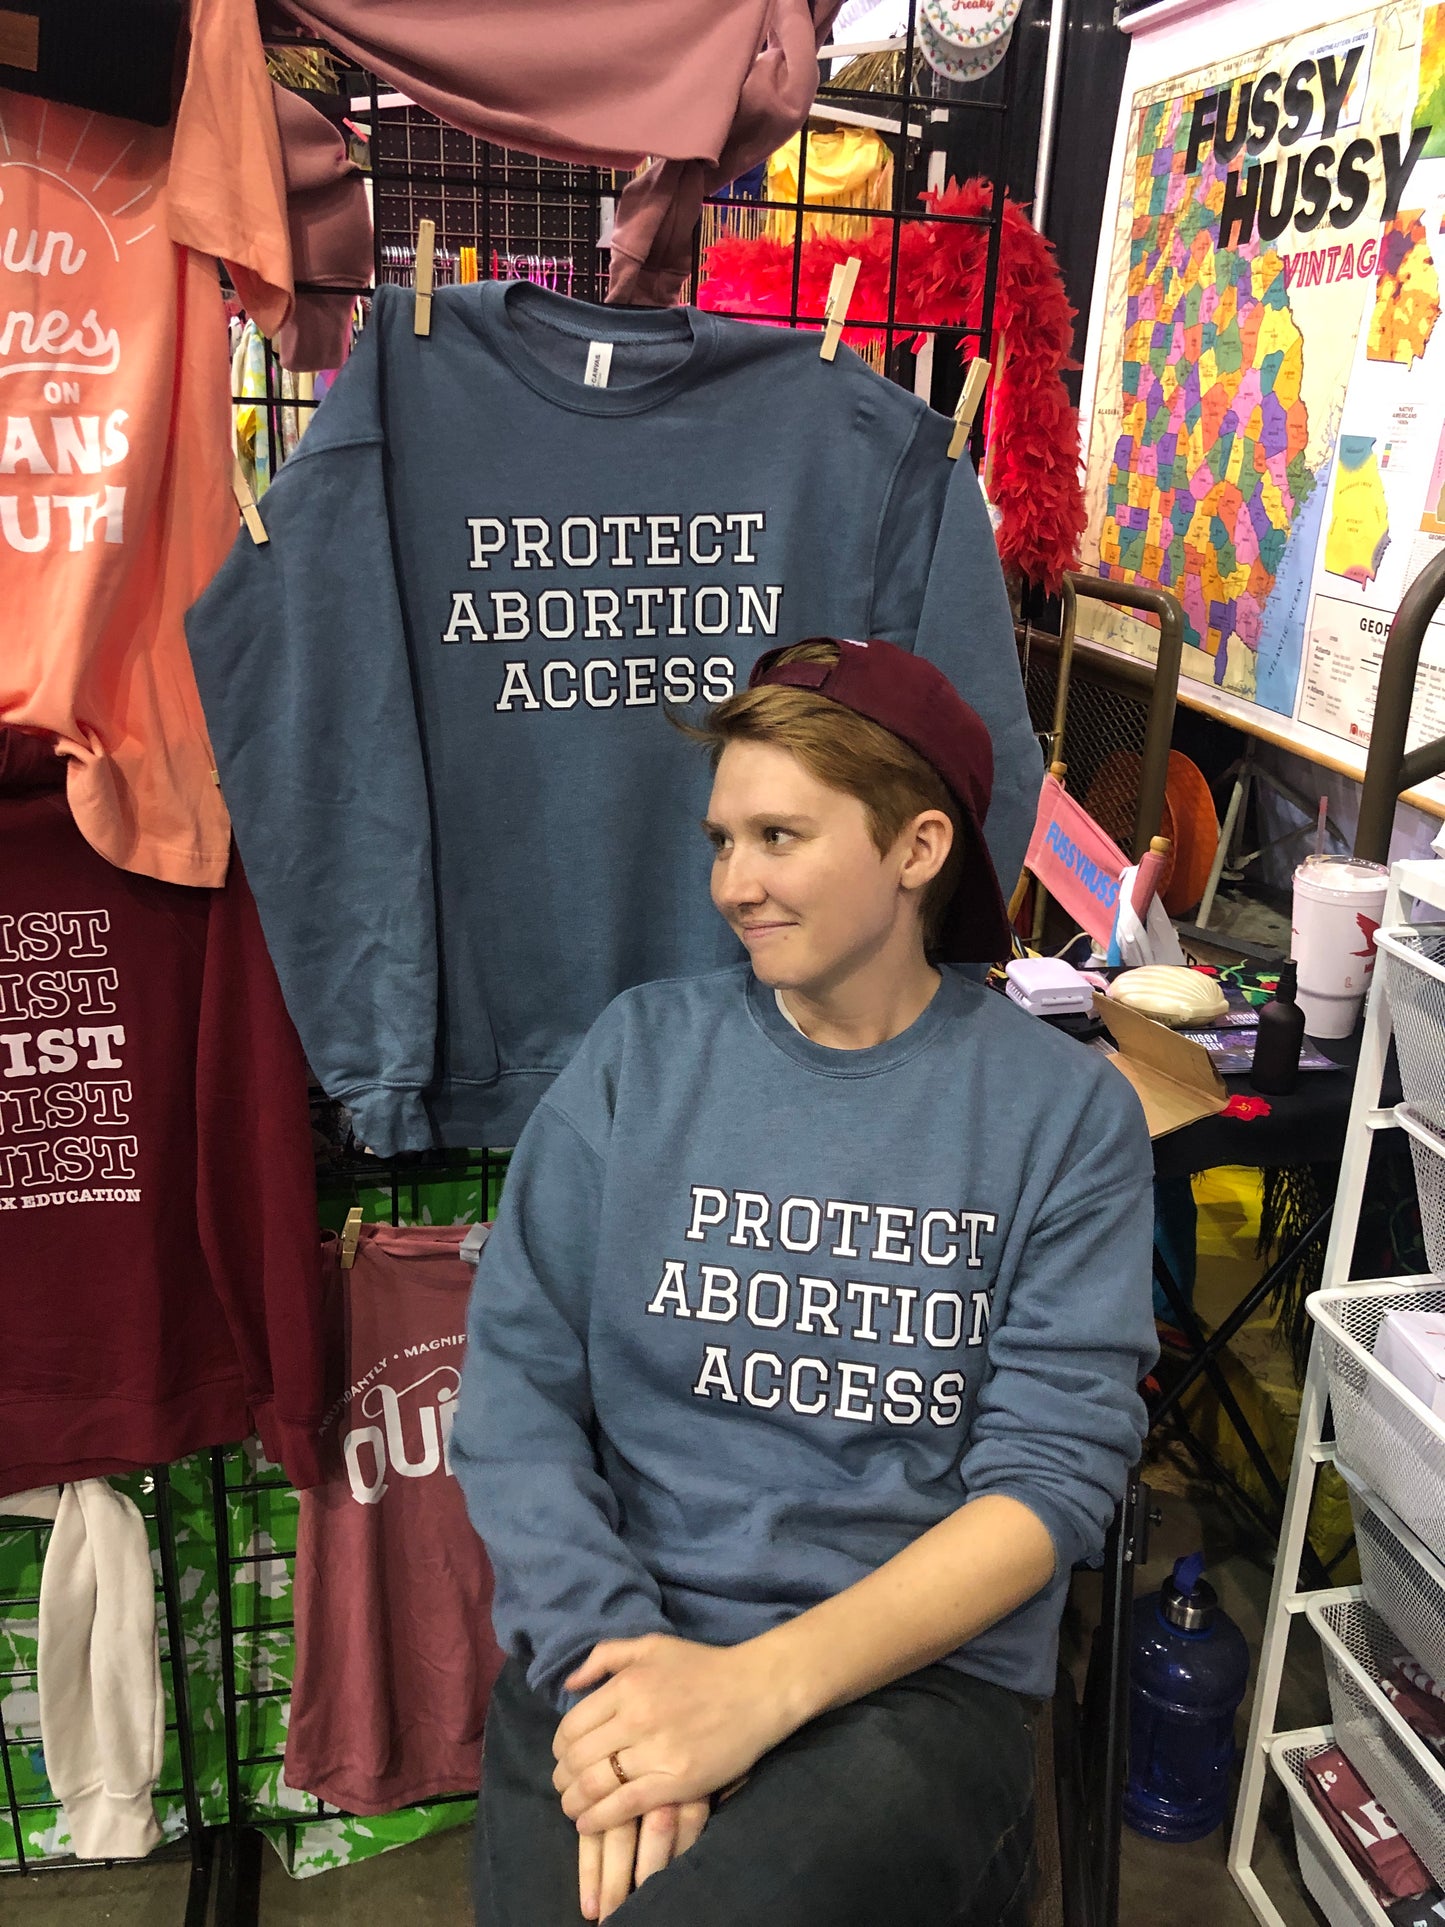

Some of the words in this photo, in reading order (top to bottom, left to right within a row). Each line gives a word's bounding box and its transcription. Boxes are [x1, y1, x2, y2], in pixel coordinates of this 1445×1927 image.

[1184, 45, 1364, 175] FUSSY
[1217, 126, 1432, 249] HUSSY
[0, 228, 87, 276] un
[43, 382, 81, 404] ON
[0, 409, 129, 475] ANS
[0, 485, 127, 553] UTH
[466, 511, 766, 570] PROTECT
[441, 585, 784, 644] ABORTION
[494, 655, 737, 712] ACCESS
[0, 909, 111, 962] IST
[0, 967, 119, 1021] IST
[0, 1025, 126, 1078] IST
[0, 1080, 132, 1135] IST
[20, 1188, 141, 1209] EDUCATION
[685, 1184, 999, 1269] PROTECT
[646, 1258, 995, 1349] ABORTION
[403, 1334, 469, 1358] MAGNIF
[692, 1344, 965, 1427] ACCESS
